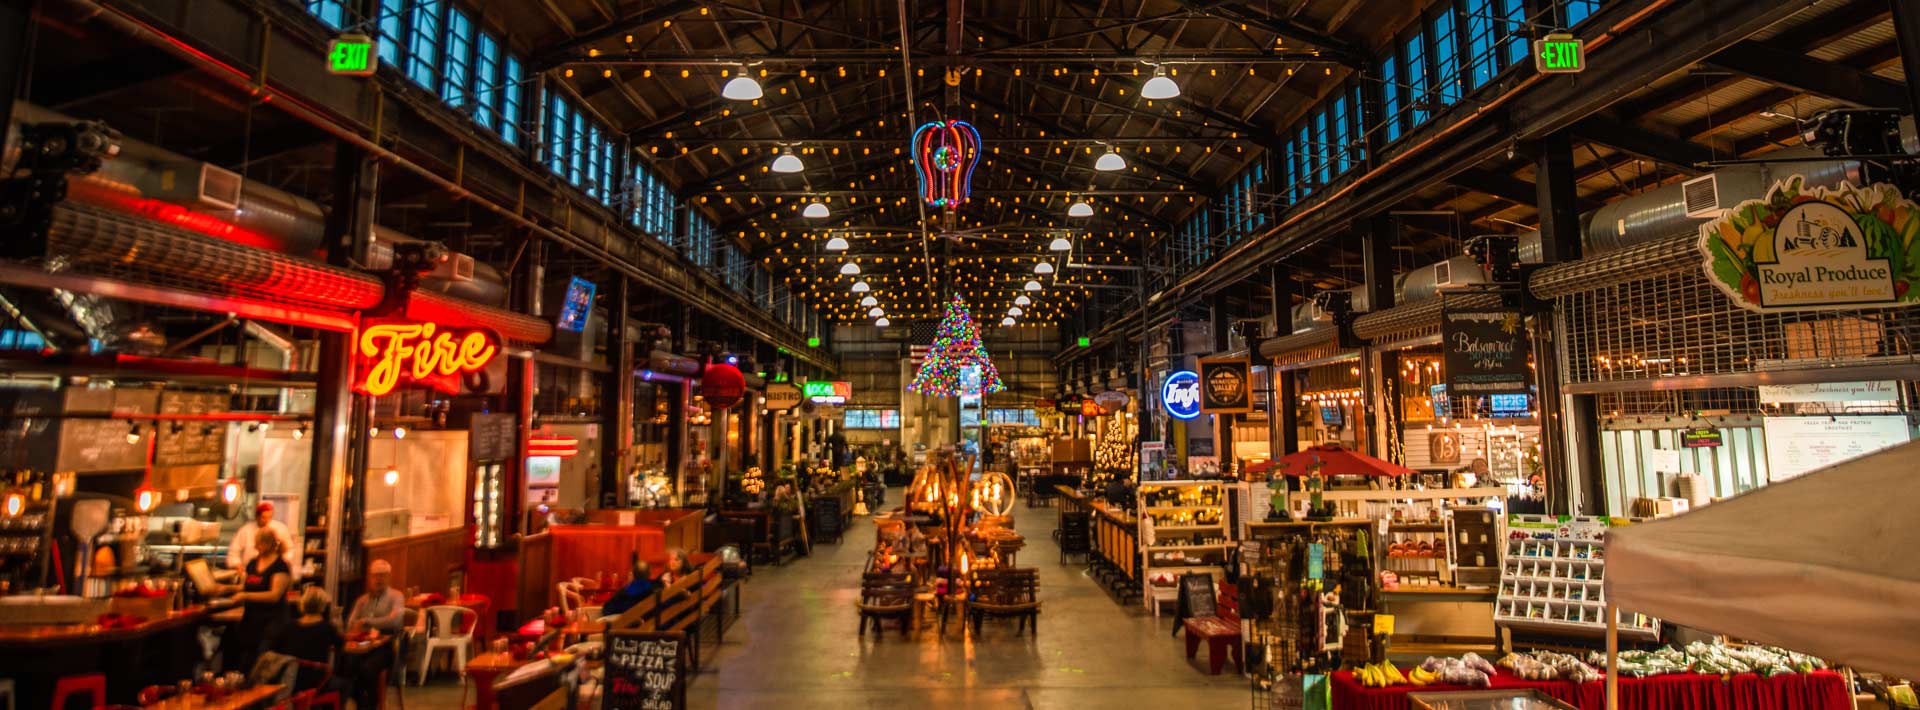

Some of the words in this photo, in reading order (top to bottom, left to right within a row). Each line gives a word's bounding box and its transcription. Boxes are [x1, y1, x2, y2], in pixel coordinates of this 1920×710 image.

[333, 42, 371, 69] EXIT
[1545, 42, 1578, 68] EXIT
[1763, 267, 1812, 288] Royal
[1815, 265, 1887, 282] Produce
[1770, 287, 1824, 300] Freshness
[1828, 285, 1857, 298] you'll
[360, 322, 495, 396] Fire
[767, 392, 800, 401] BISTRO
[620, 654, 664, 669] PIZZA
[644, 671, 676, 691] SOUP
